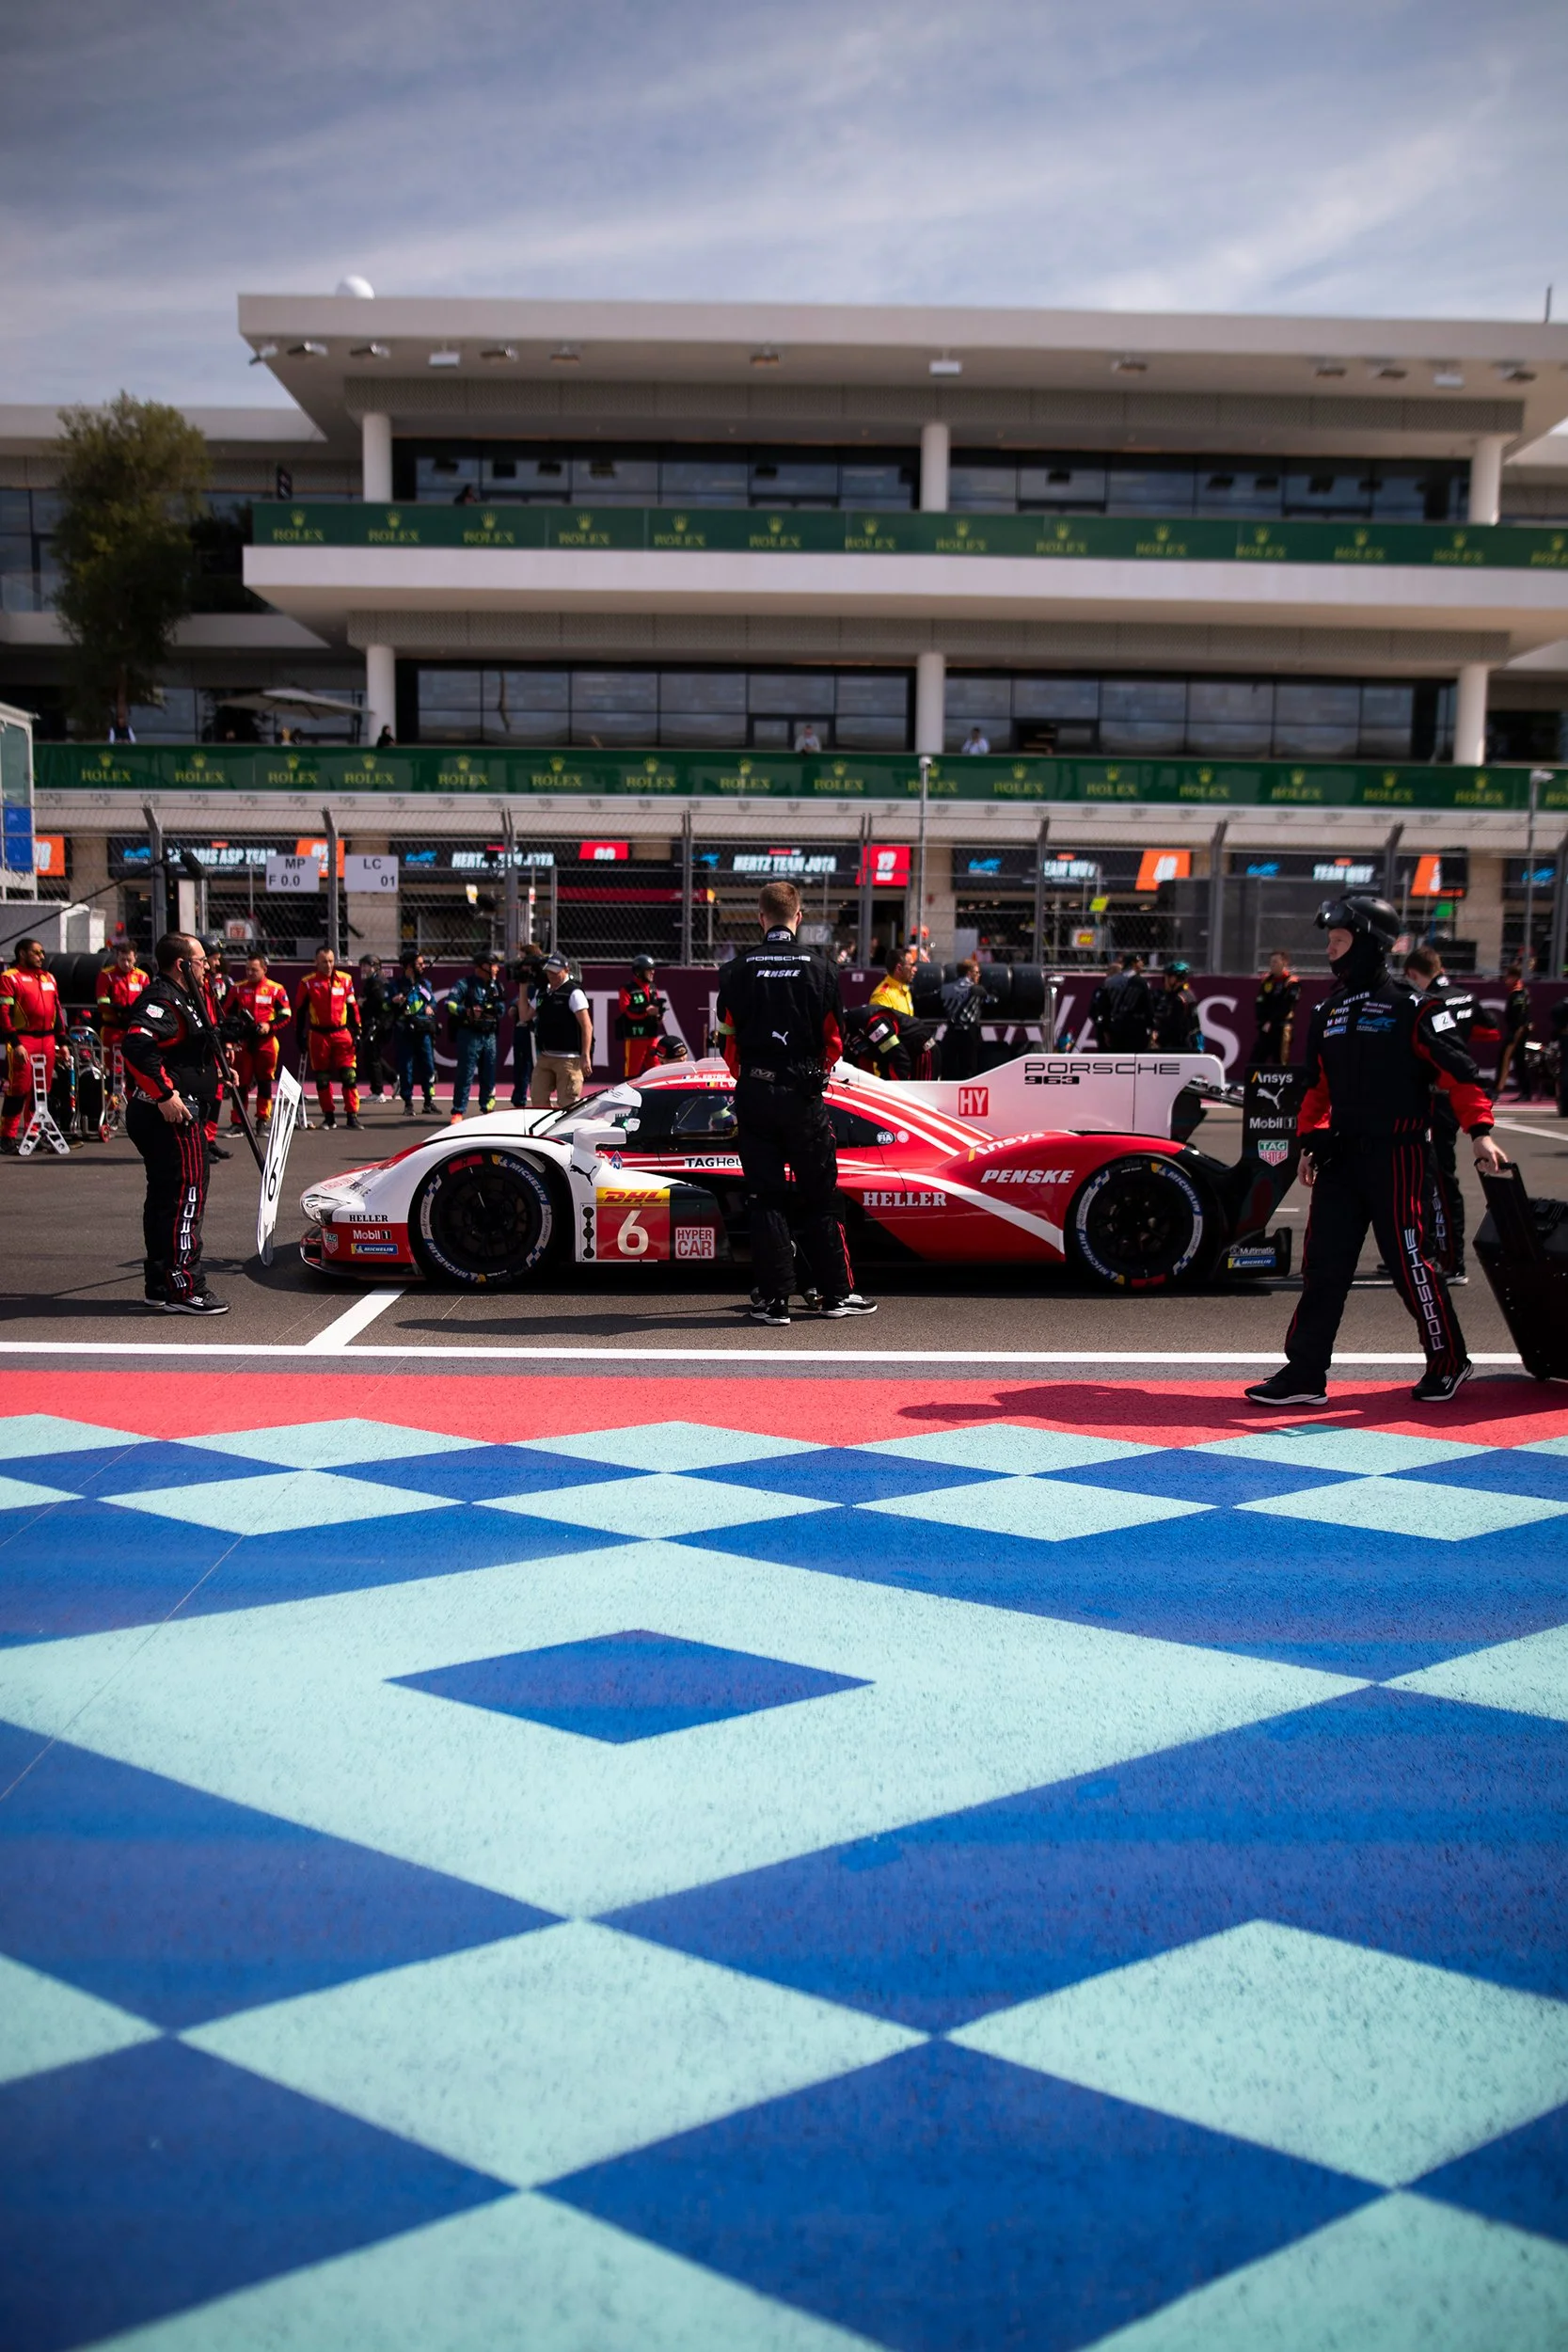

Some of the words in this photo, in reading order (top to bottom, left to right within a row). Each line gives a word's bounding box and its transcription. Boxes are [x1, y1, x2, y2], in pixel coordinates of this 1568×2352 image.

[273, 528, 324, 543] ROLEX
[368, 528, 420, 544] ROLEX
[463, 530, 514, 545] ROLEX
[559, 532, 609, 546] ROLEX
[654, 533, 705, 548] ROLEX
[750, 534, 800, 548] ROLEX
[845, 536, 895, 549] ROLEX
[82, 768, 132, 783] ROLEX
[175, 769, 225, 784] ROLEX
[268, 771, 318, 785] ROLEX
[344, 771, 394, 785] ROLEX
[438, 772, 488, 787] ROLEX
[531, 774, 582, 788] ROLEX
[626, 776, 676, 789] ROLEX
[720, 777, 770, 791] ROLEX
[814, 778, 863, 792] ROLEX
[994, 782, 1044, 795] ROLEX
[1086, 783, 1136, 797] ROLEX
[1180, 786, 1229, 800] ROLEX
[1272, 787, 1322, 801] ROLEX
[1364, 788, 1414, 803] ROLEX
[1455, 790, 1504, 805] ROLEX
[285, 858, 306, 870] MP
[364, 858, 382, 870] LC
[451, 851, 489, 868] HERT
[733, 854, 771, 872] HERTZ
[772, 855, 805, 871] TEAM
[804, 856, 836, 872] JOTA
[269, 875, 277, 887] F
[280, 875, 300, 887] 0.0
[380, 876, 395, 887] 01
[756, 969, 800, 977] PENSKE
[1342, 991, 1370, 1006] HELLER
[1329, 1006, 1350, 1016] Ansys
[1442, 1015, 1449, 1025] 2
[632, 1026, 644, 1035] TV
[1024, 1062, 1180, 1075] PORSCHE
[1024, 1075, 1081, 1085] 963
[1251, 1071, 1293, 1086] Ansys
[961, 1089, 987, 1114] HY
[1249, 1117, 1283, 1129] Mobil
[877, 1134, 893, 1143] FIA
[968, 1131, 1045, 1162] Ansys
[1261, 1142, 1286, 1151] TAG
[1260, 1151, 1287, 1165] HEUER
[268, 1157, 279, 1201] 6
[509, 1162, 547, 1201] MICHELIN
[980, 1169, 1075, 1184] PENSKE
[603, 1191, 664, 1203] DHL
[1167, 1170, 1200, 1212] MICHELIN
[863, 1192, 947, 1207] HELLER
[353, 1230, 381, 1240] Mobil
[617, 1210, 649, 1256] 6
[677, 1230, 712, 1240] HYPER
[677, 1240, 712, 1256] CAR
[1079, 1232, 1109, 1276] MICHELIN
[1240, 1247, 1275, 1256] Multimatic
[427, 1242, 468, 1279] MICHELIN
[1404, 1228, 1445, 1351] PORSCHE
